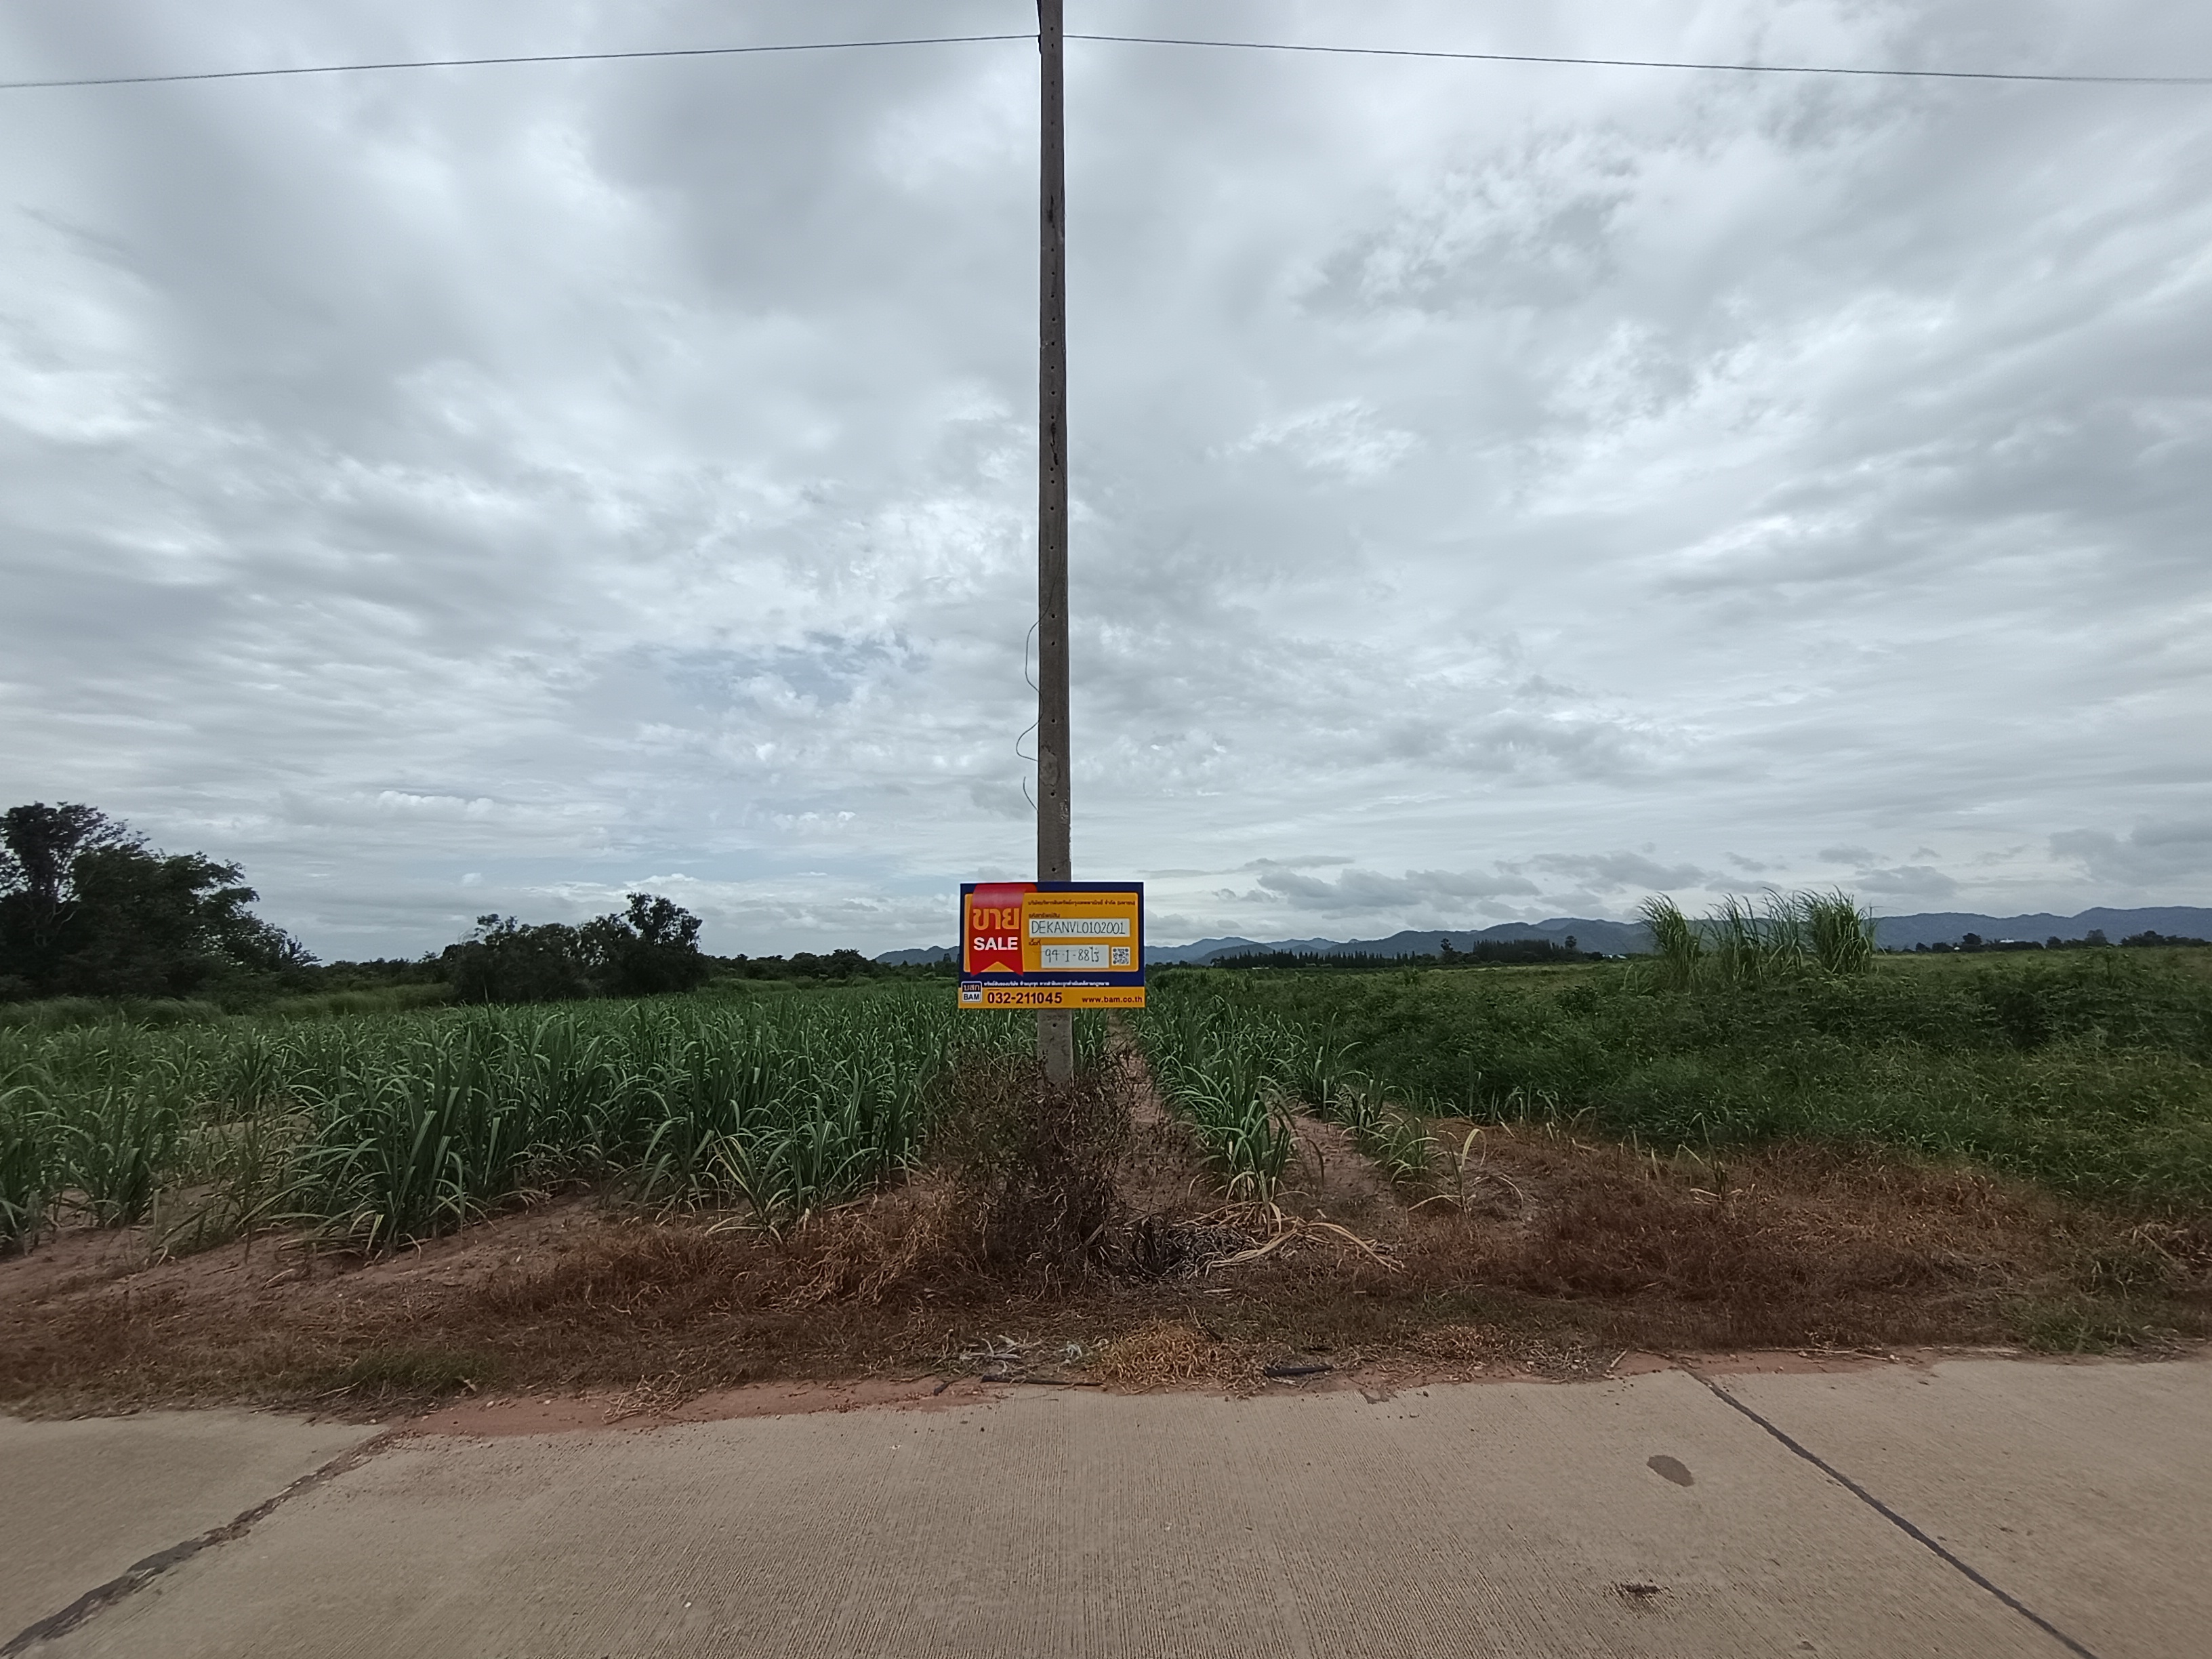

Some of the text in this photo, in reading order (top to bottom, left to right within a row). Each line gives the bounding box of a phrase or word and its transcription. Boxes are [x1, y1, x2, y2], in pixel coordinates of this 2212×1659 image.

[972, 908, 1020, 930] ขาย
[1031, 920, 1126, 935] DEKANVL0102001
[973, 937, 1019, 951] SALE
[987, 992, 1063, 1004] 032-211045
